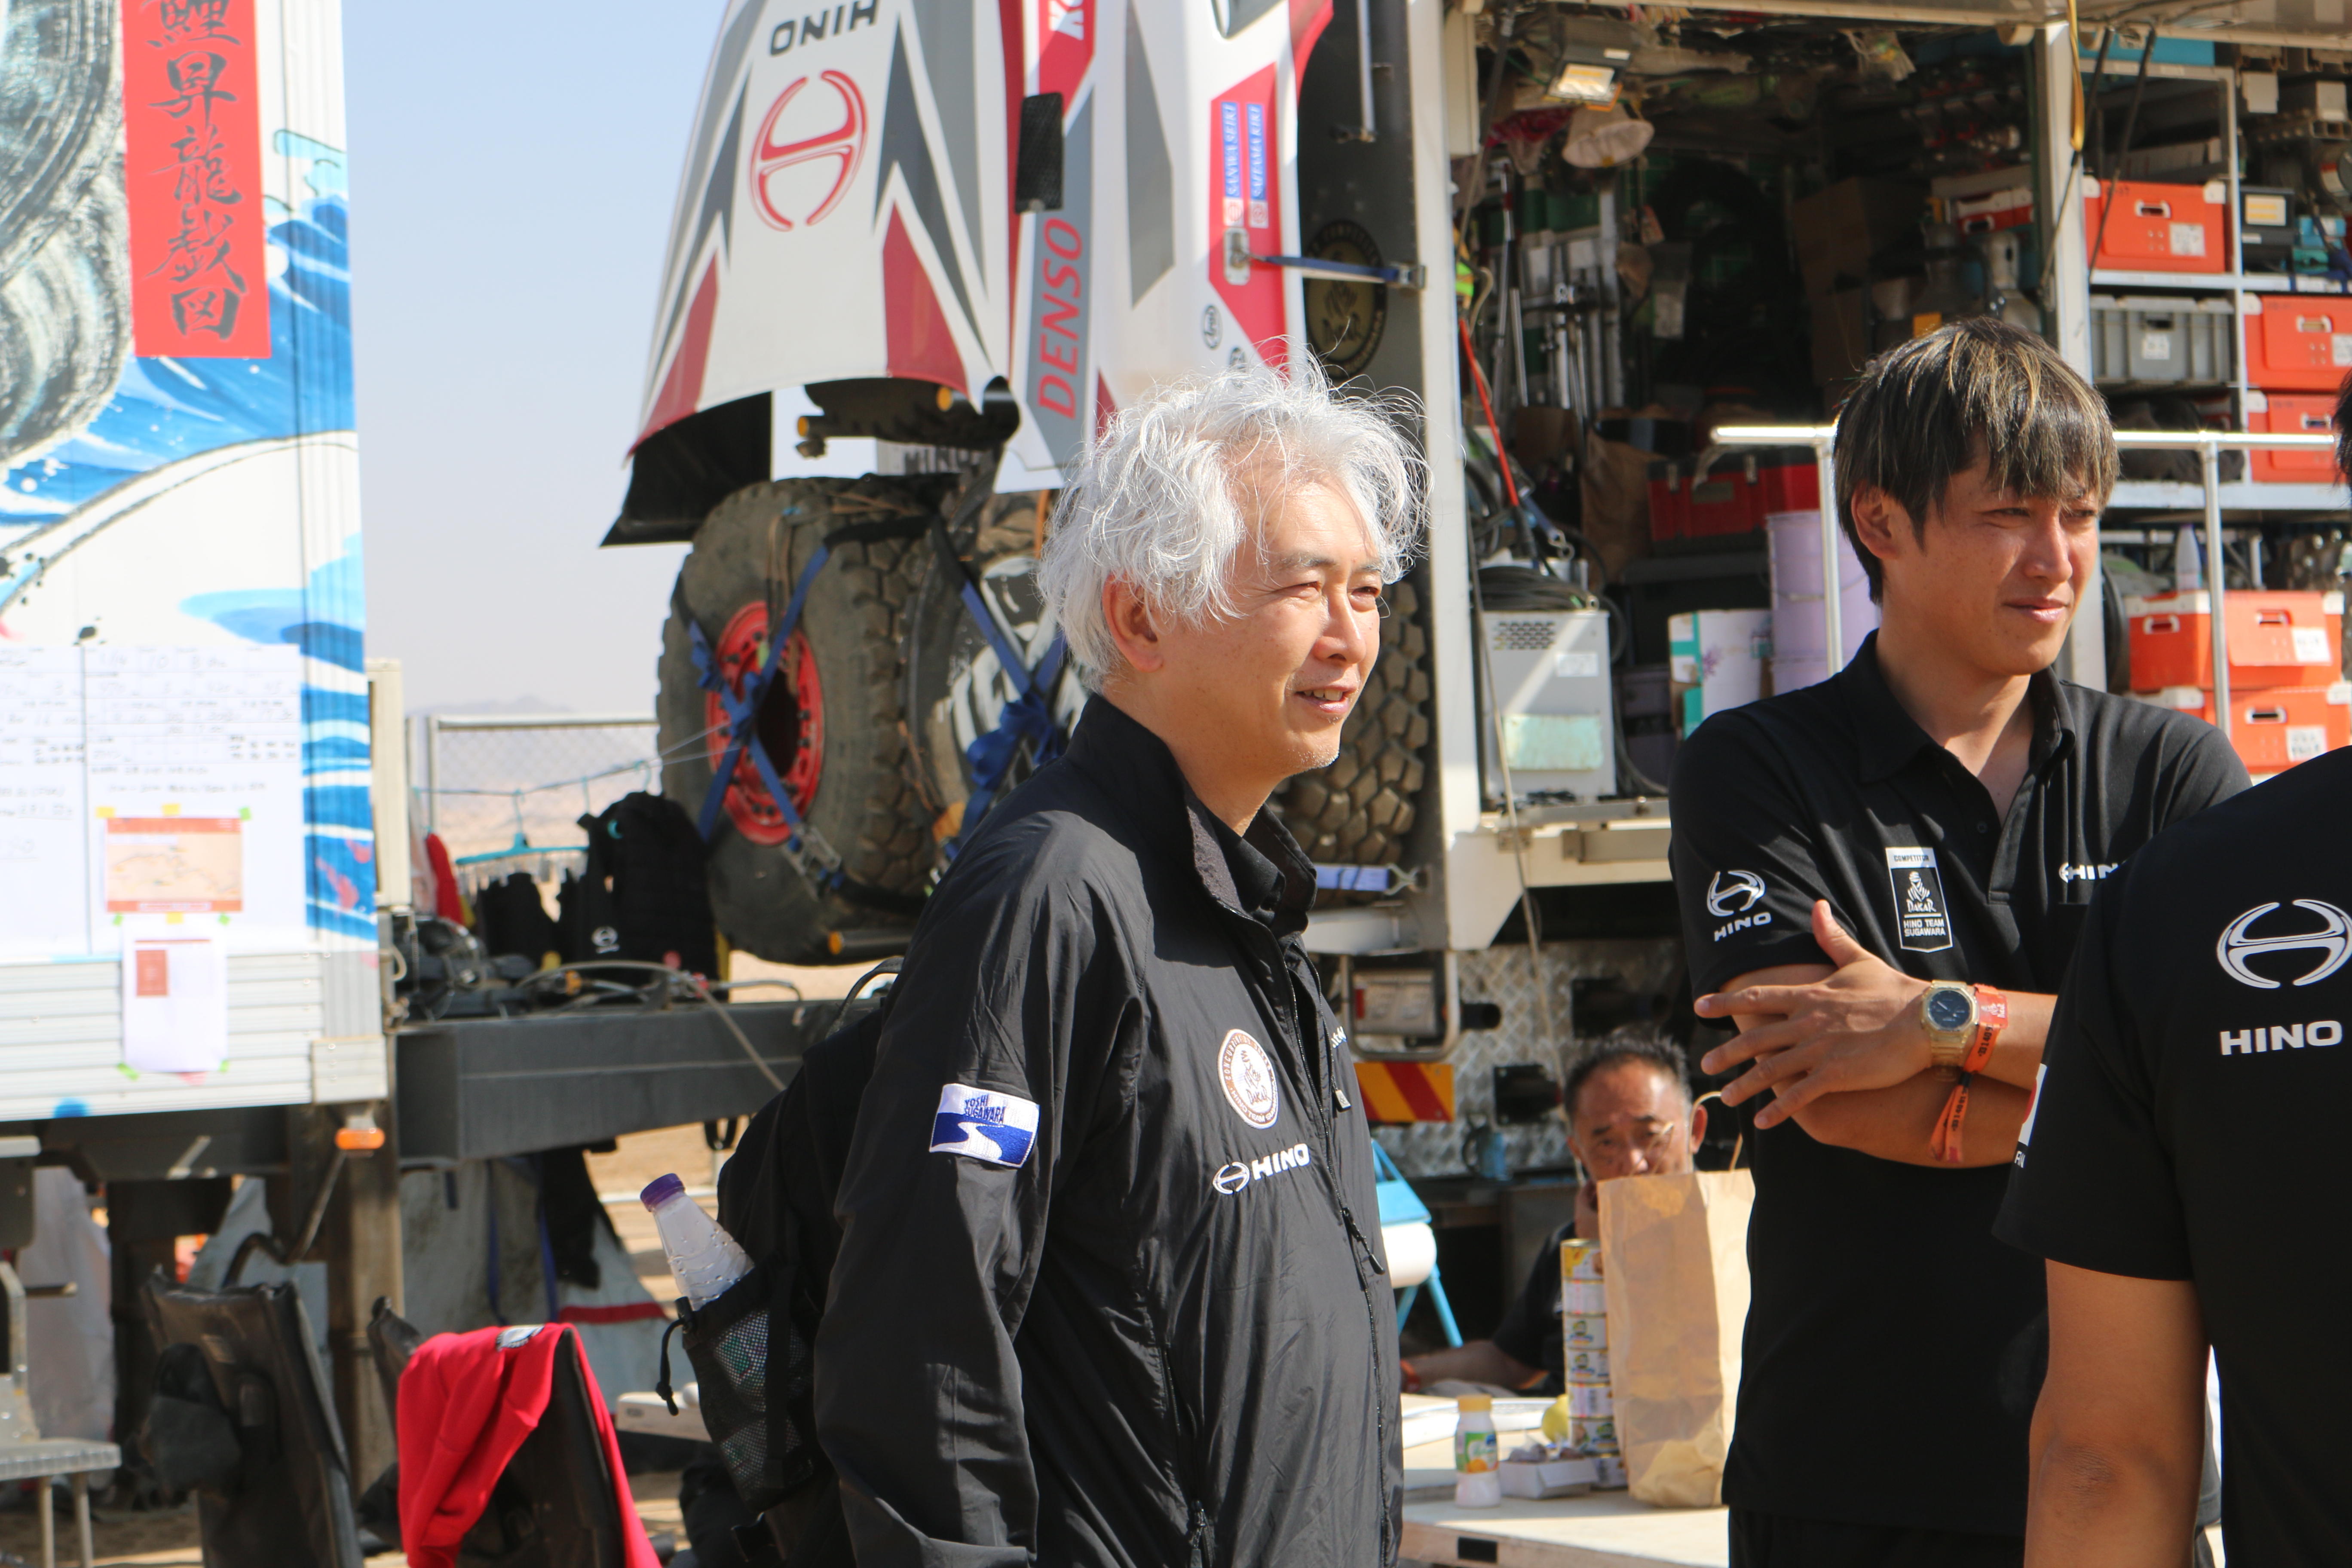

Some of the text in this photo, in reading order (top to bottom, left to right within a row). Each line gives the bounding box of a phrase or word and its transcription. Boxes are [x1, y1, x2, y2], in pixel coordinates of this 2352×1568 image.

[769, 0, 881, 57] HINO
[1039, 219, 1083, 420] DENSO
[1893, 854, 1930, 862] COMPETITOR
[2068, 863, 2119, 880] HIN
[1906, 898, 1936, 913] DAKAR
[1714, 912, 1771, 942] HINO
[1904, 919, 1945, 929] HINO TEAM
[1904, 928, 1946, 937] SUGAWARA
[2219, 1020, 2343, 1056] HINO
[965, 1093, 989, 1108] YOSHI
[1231, 1090, 1248, 1113] HINO
[1247, 1110, 1266, 1122] TEAM
[964, 1106, 1006, 1123] SUGAWARA
[1251, 1143, 1310, 1180] HINO
